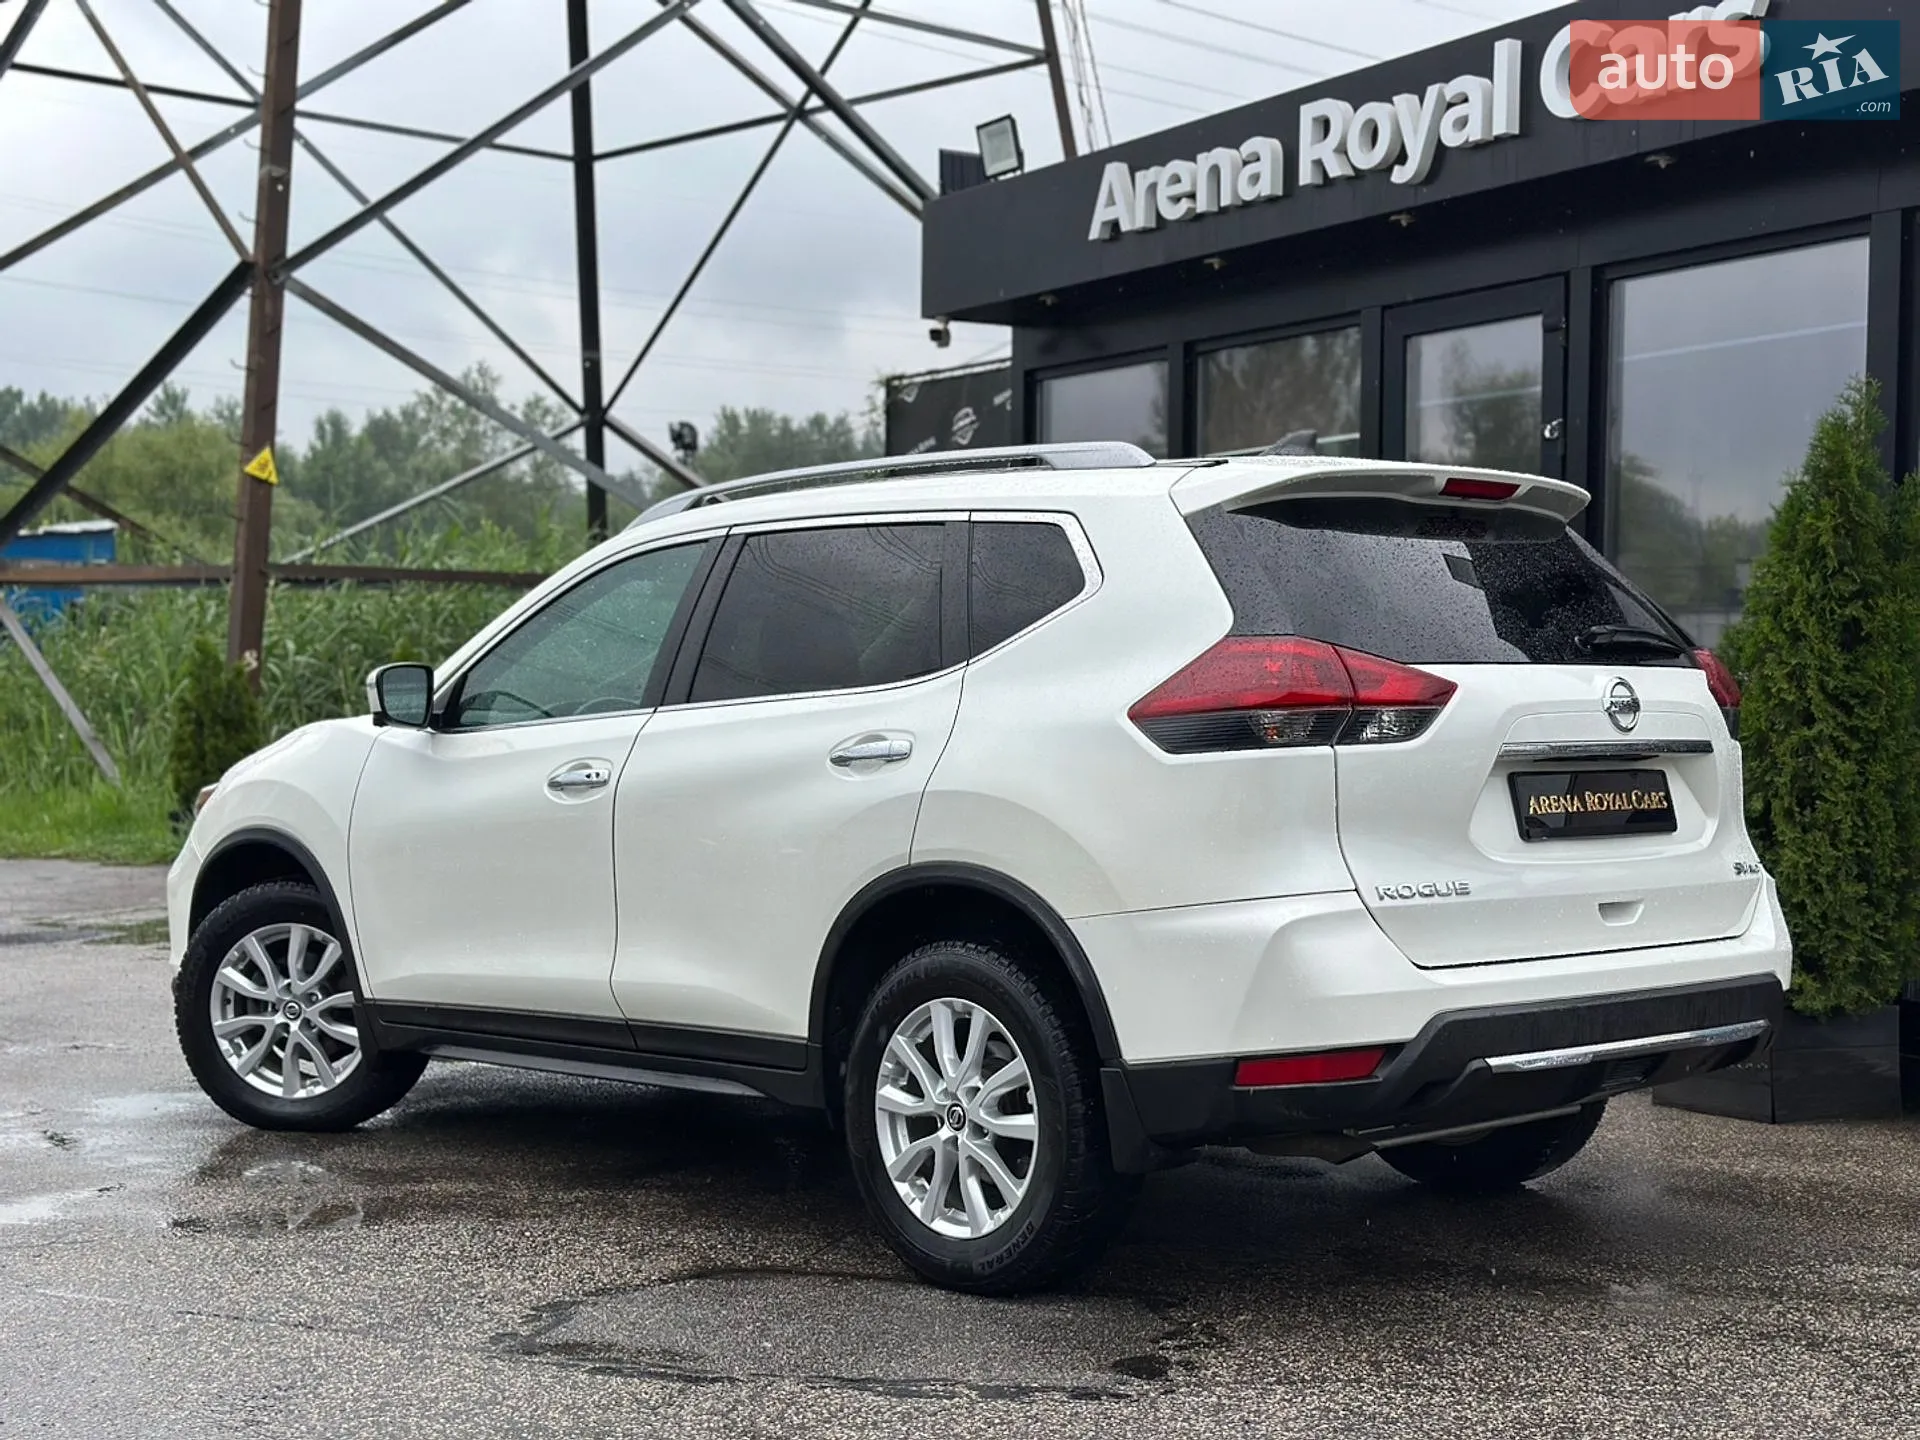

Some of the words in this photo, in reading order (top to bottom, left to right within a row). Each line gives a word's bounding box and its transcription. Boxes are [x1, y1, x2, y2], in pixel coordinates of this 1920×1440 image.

[1088, 136, 1284, 240] Arena
[1299, 38, 1522, 186] Royal
[1529, 795, 1584, 815] ARENA
[1585, 791, 1632, 812] ROYAL
[1374, 880, 1471, 901] ROGUE
